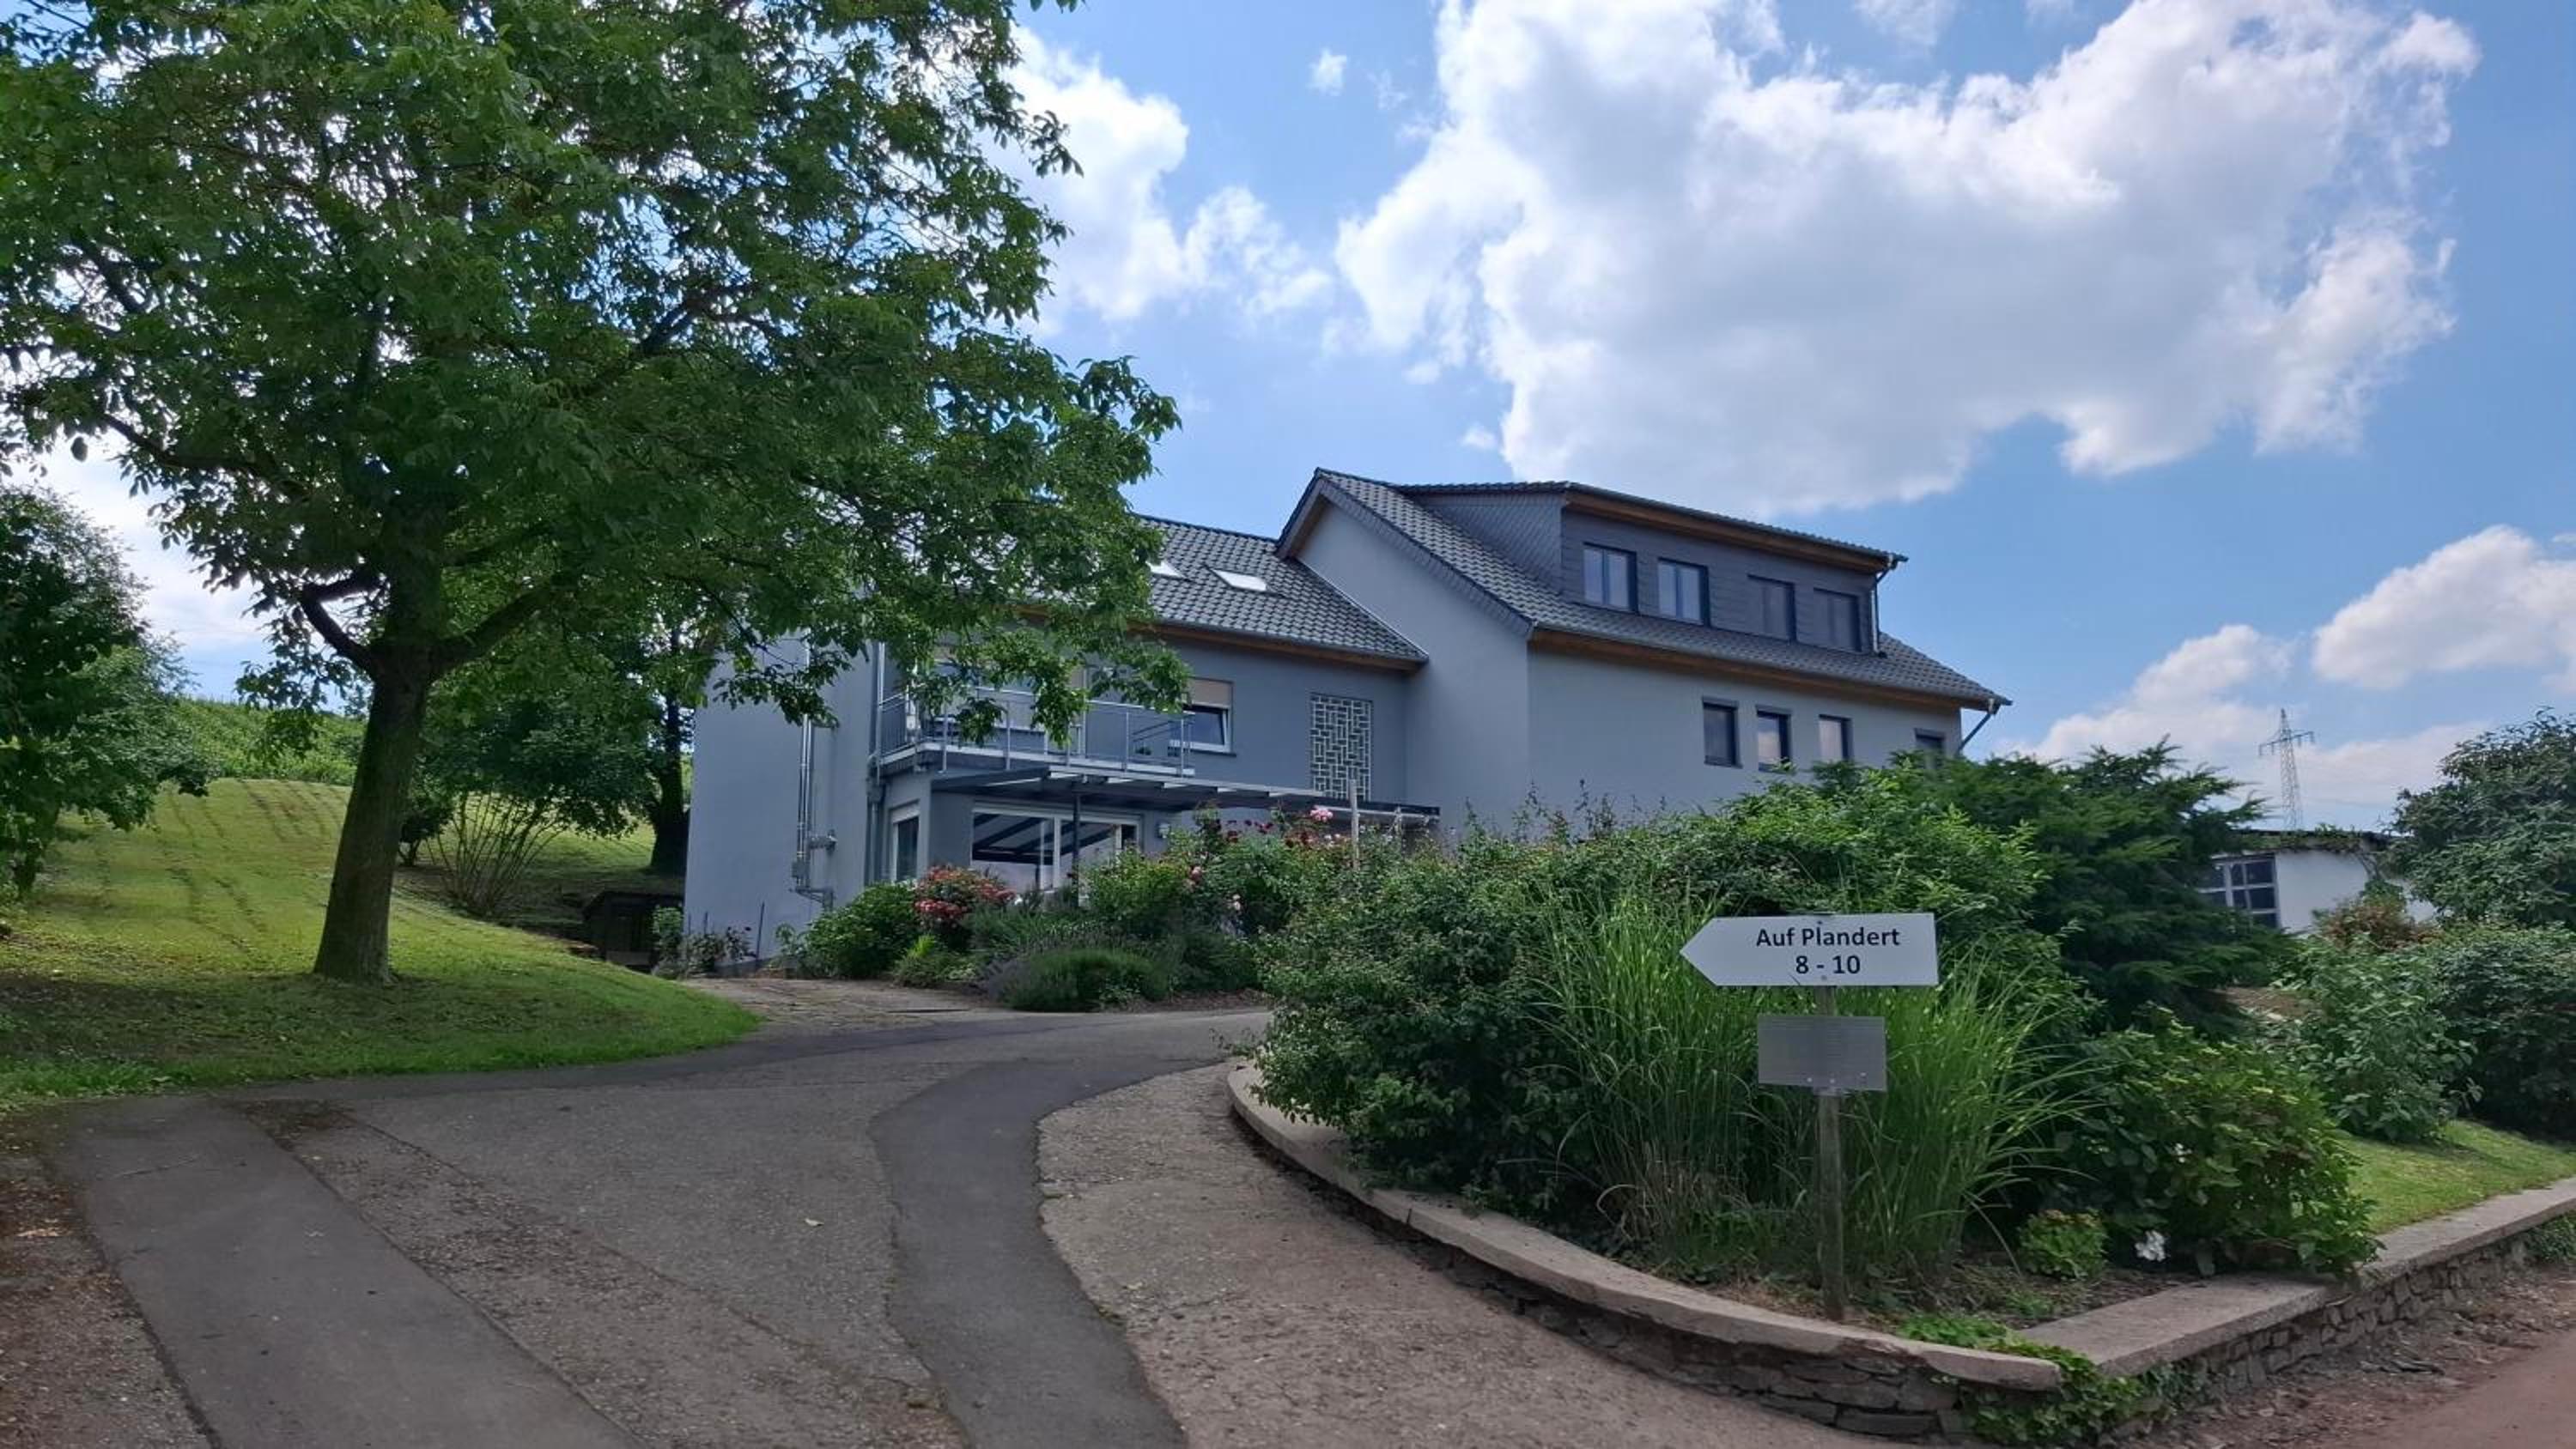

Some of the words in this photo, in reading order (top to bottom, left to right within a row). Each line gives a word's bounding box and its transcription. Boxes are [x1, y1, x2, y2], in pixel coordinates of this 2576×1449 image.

[1756, 927, 1795, 947] Auf
[1802, 927, 1900, 946] Plandert
[1795, 955, 1809, 974] 8
[1832, 955, 1861, 974] 10
